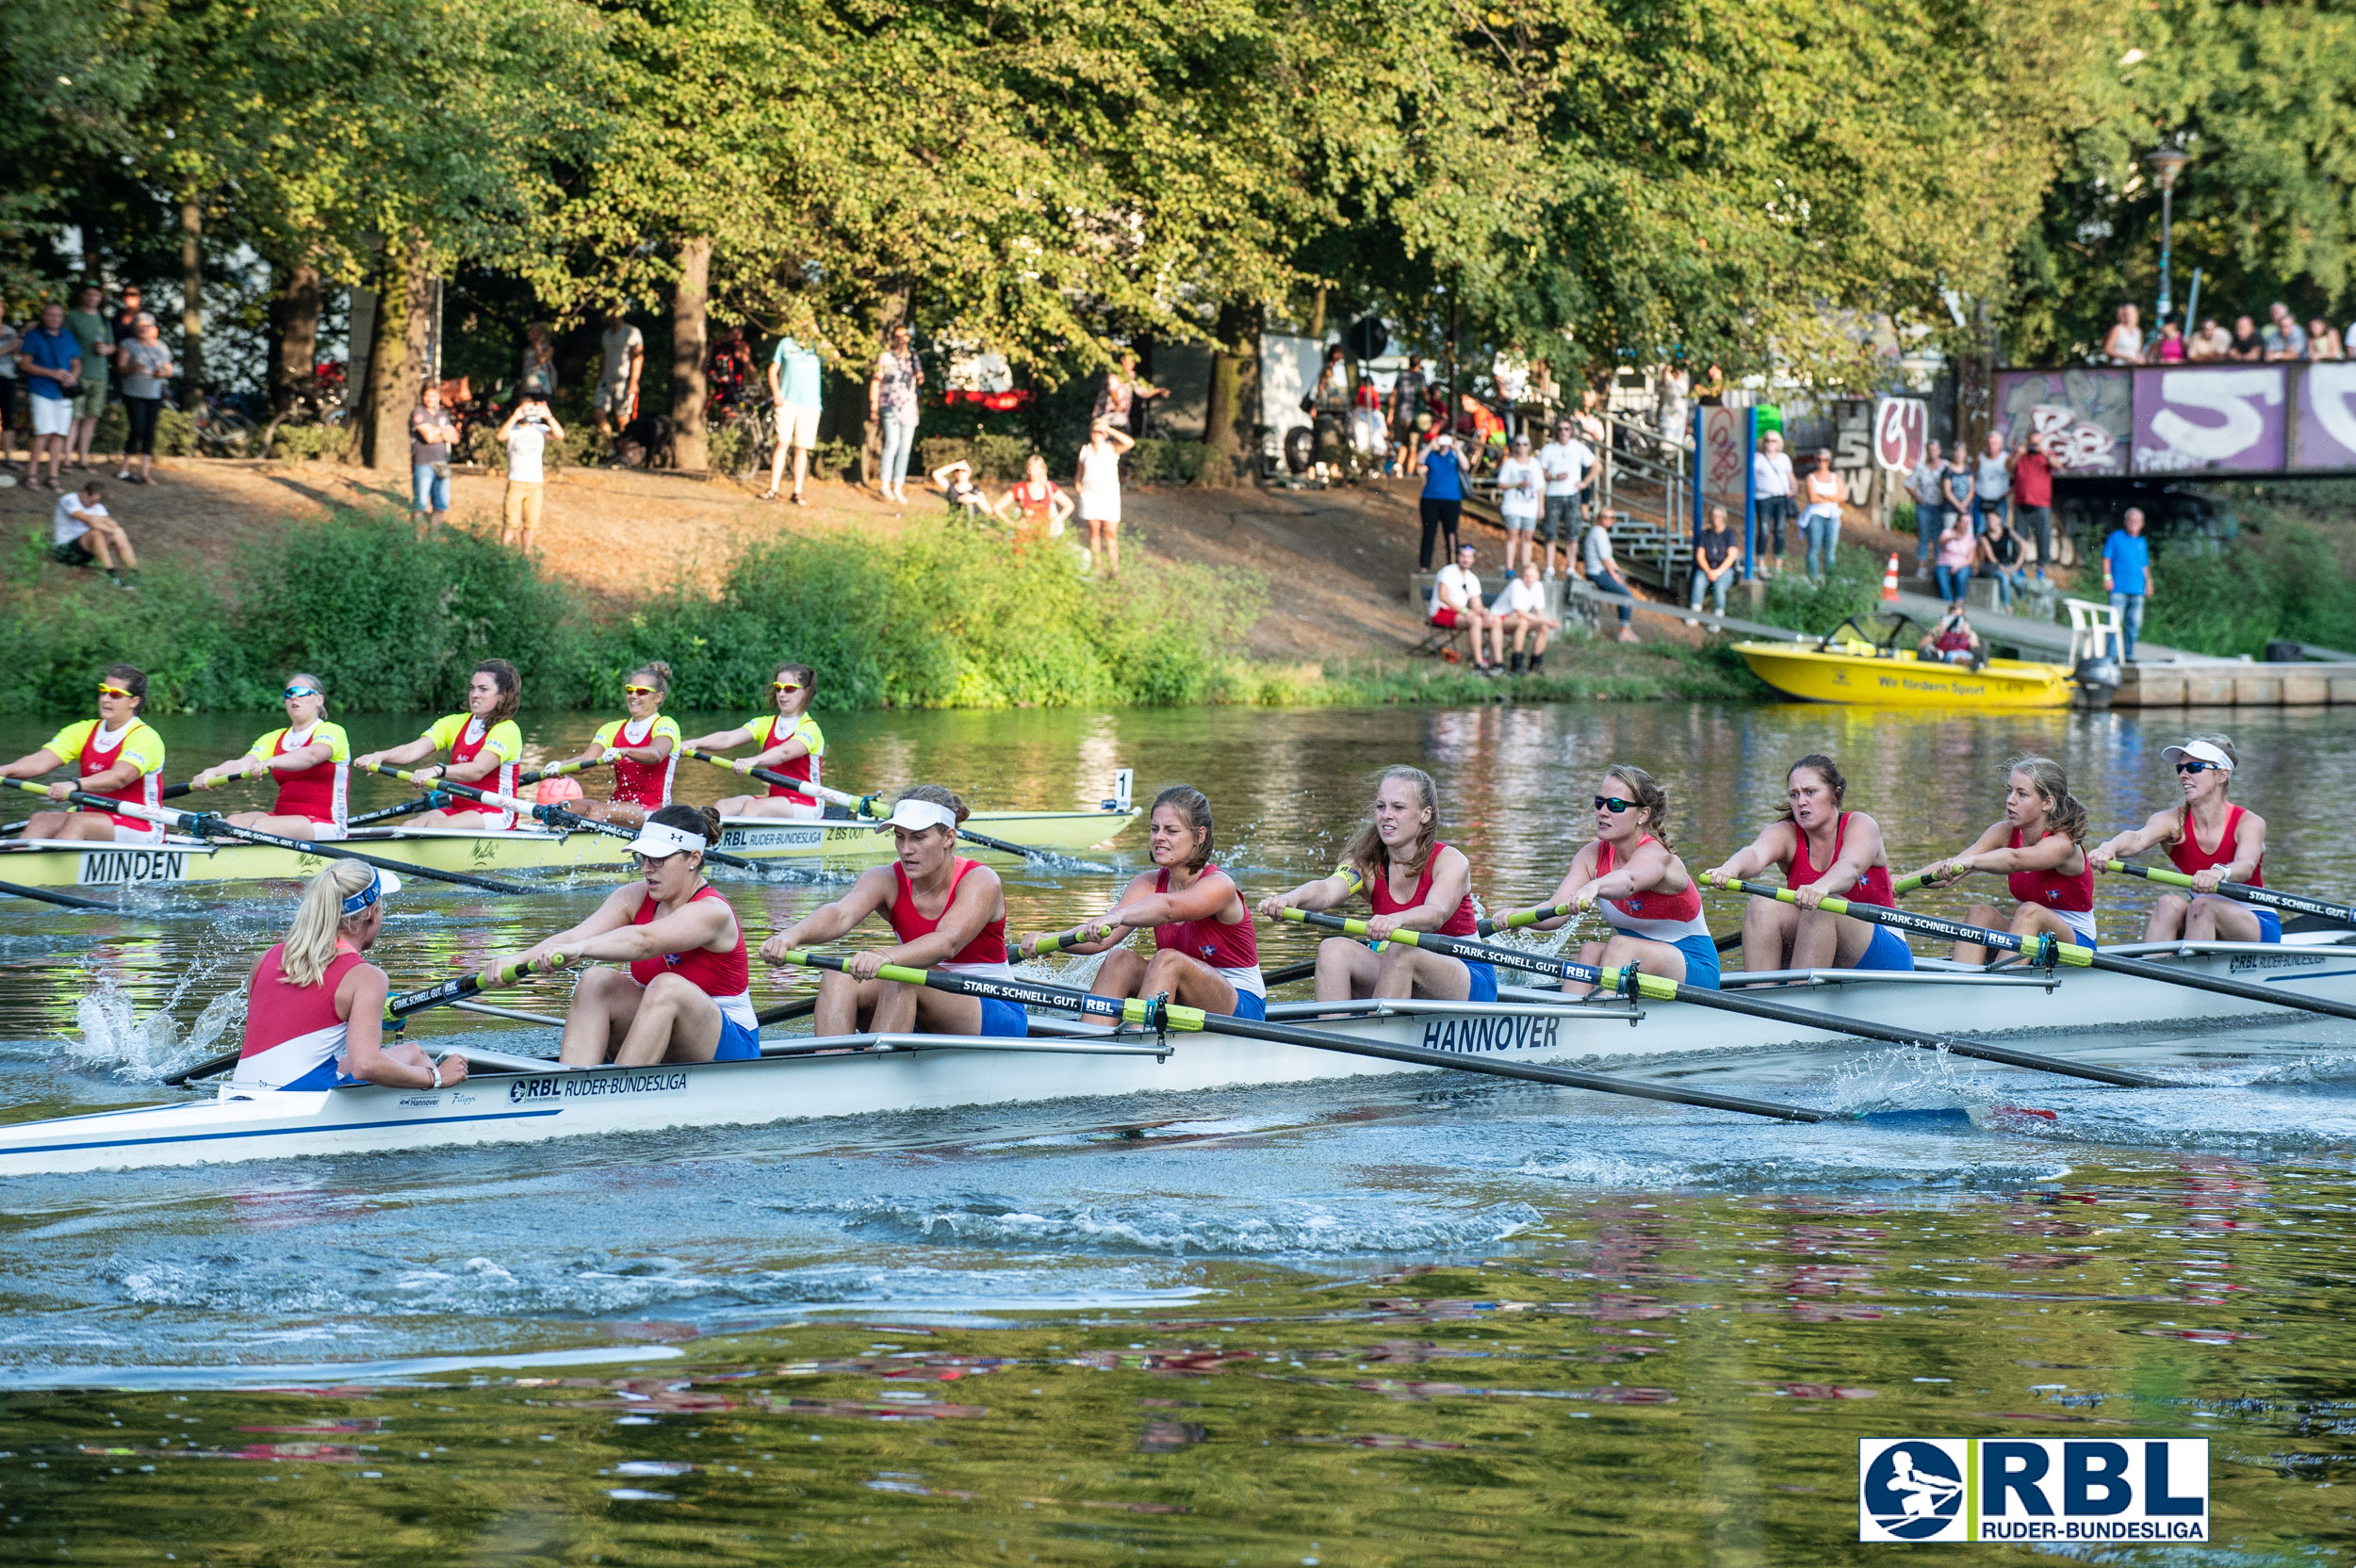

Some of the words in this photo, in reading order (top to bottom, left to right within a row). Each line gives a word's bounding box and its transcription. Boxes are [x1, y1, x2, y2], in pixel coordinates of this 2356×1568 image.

[1119, 772, 1126, 797] 1
[723, 831, 747, 847] RBL
[748, 830, 823, 846] RUDER-BUNDESLIGA
[826, 827, 835, 841] Z
[835, 827, 847, 841] BS
[84, 851, 183, 883] MINDEN
[2248, 890, 2280, 905] STARK.
[2281, 897, 2325, 914] SCHNELL.
[2325, 906, 2348, 920] GUT.
[1880, 911, 1913, 926] STARK.
[1914, 918, 1958, 936] SCHNELL.
[1959, 927, 1981, 940] GUT.
[1988, 932, 2013, 946] RBL
[1451, 943, 1486, 959] STARK.
[1487, 950, 1534, 970] SCHNELL.
[1535, 961, 1559, 974] GUT.
[1565, 965, 1593, 980] RBL
[2238, 955, 2258, 970] RBL
[393, 998, 410, 1011] STARK.
[408, 990, 430, 1006] SCHNELL.
[430, 987, 443, 999] GUT.
[444, 980, 458, 994] RBL
[962, 980, 1000, 996] STARK.
[1002, 987, 1052, 1004] SCHNELL.
[1053, 995, 1078, 1008] GUT.
[1086, 999, 1114, 1013] RBL
[1422, 1015, 1561, 1054] HANNOVER
[527, 1078, 562, 1098] RBL
[564, 1072, 687, 1097] RUDER-BUNDESLIGA
[410, 1098, 439, 1107] Hannover
